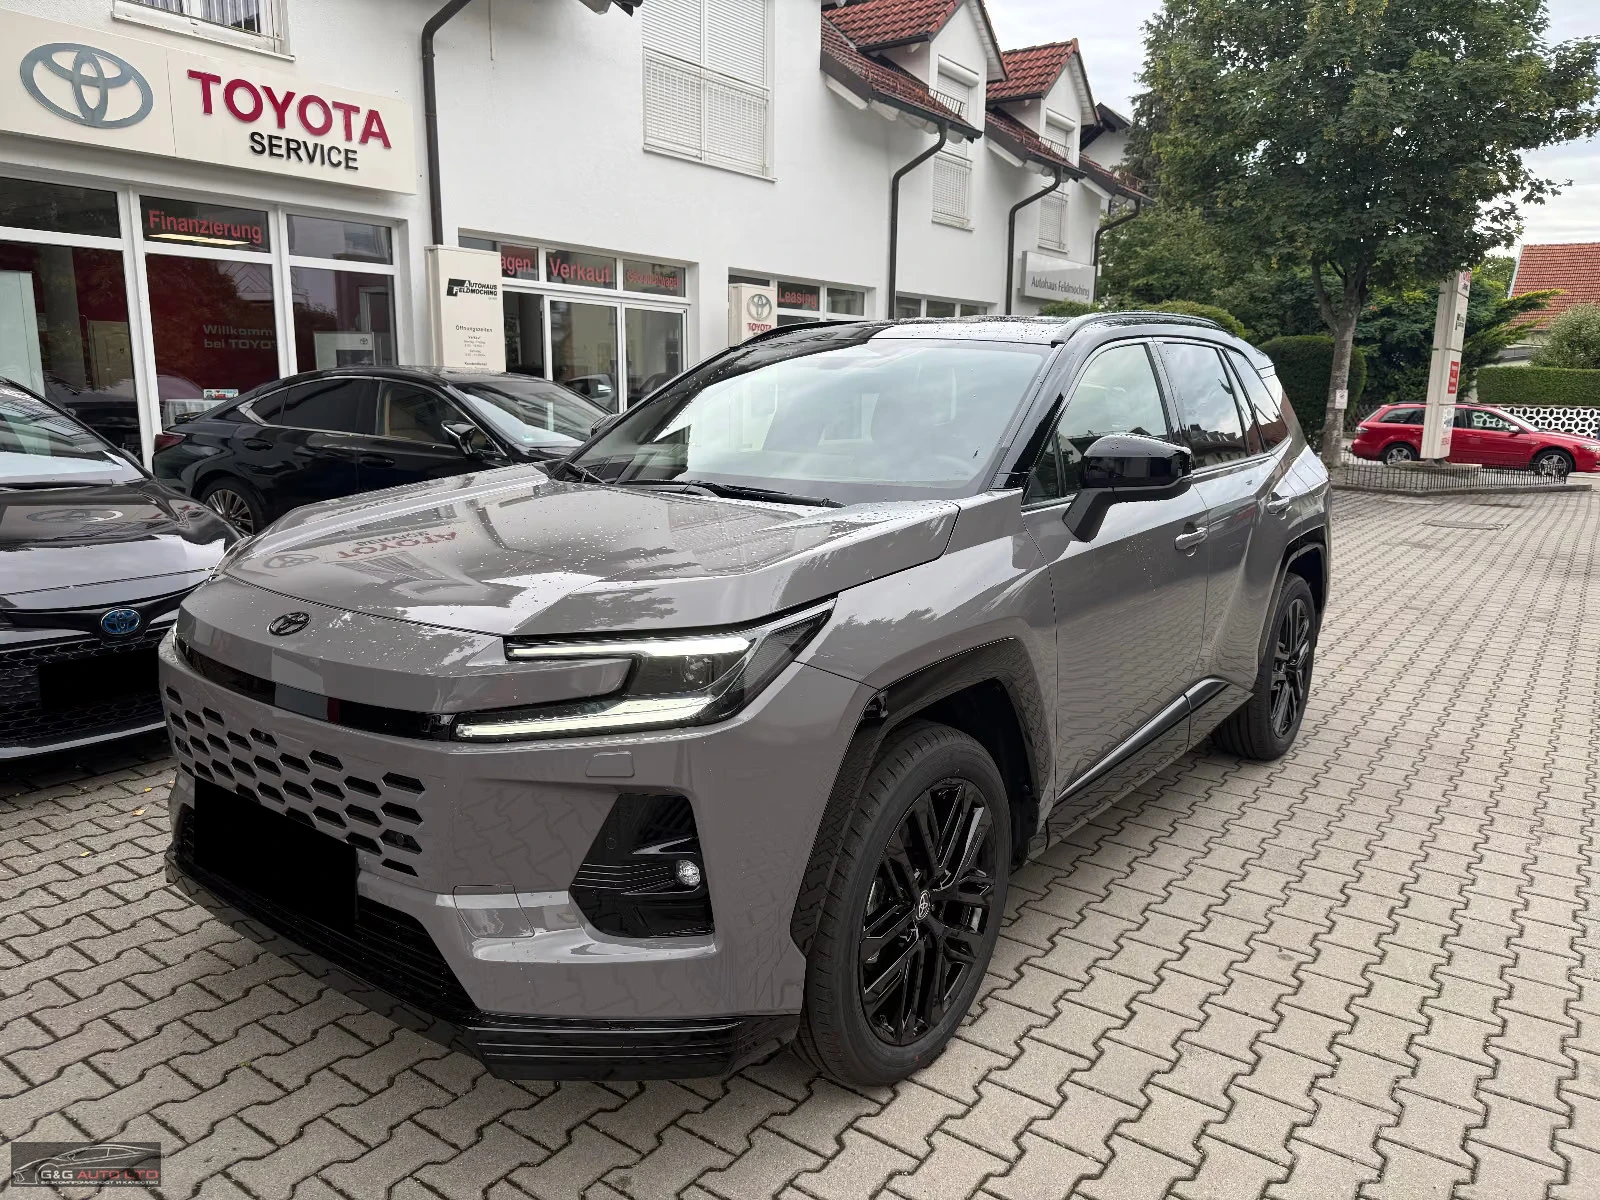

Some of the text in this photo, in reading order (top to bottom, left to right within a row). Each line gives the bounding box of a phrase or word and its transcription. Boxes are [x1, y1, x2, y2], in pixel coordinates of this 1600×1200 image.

[187, 69, 392, 149] TOYOTA
[249, 131, 359, 171] SERVICE
[148, 210, 263, 244] Finanzierung
[501, 255, 532, 276] agen
[550, 258, 611, 283] Verkauf
[464, 280, 498, 290] AUTOHAUS
[1031, 276, 1090, 299] Autohaus Feldmoching
[779, 287, 817, 308] Leasing
[203, 324, 273, 337] Willkomm
